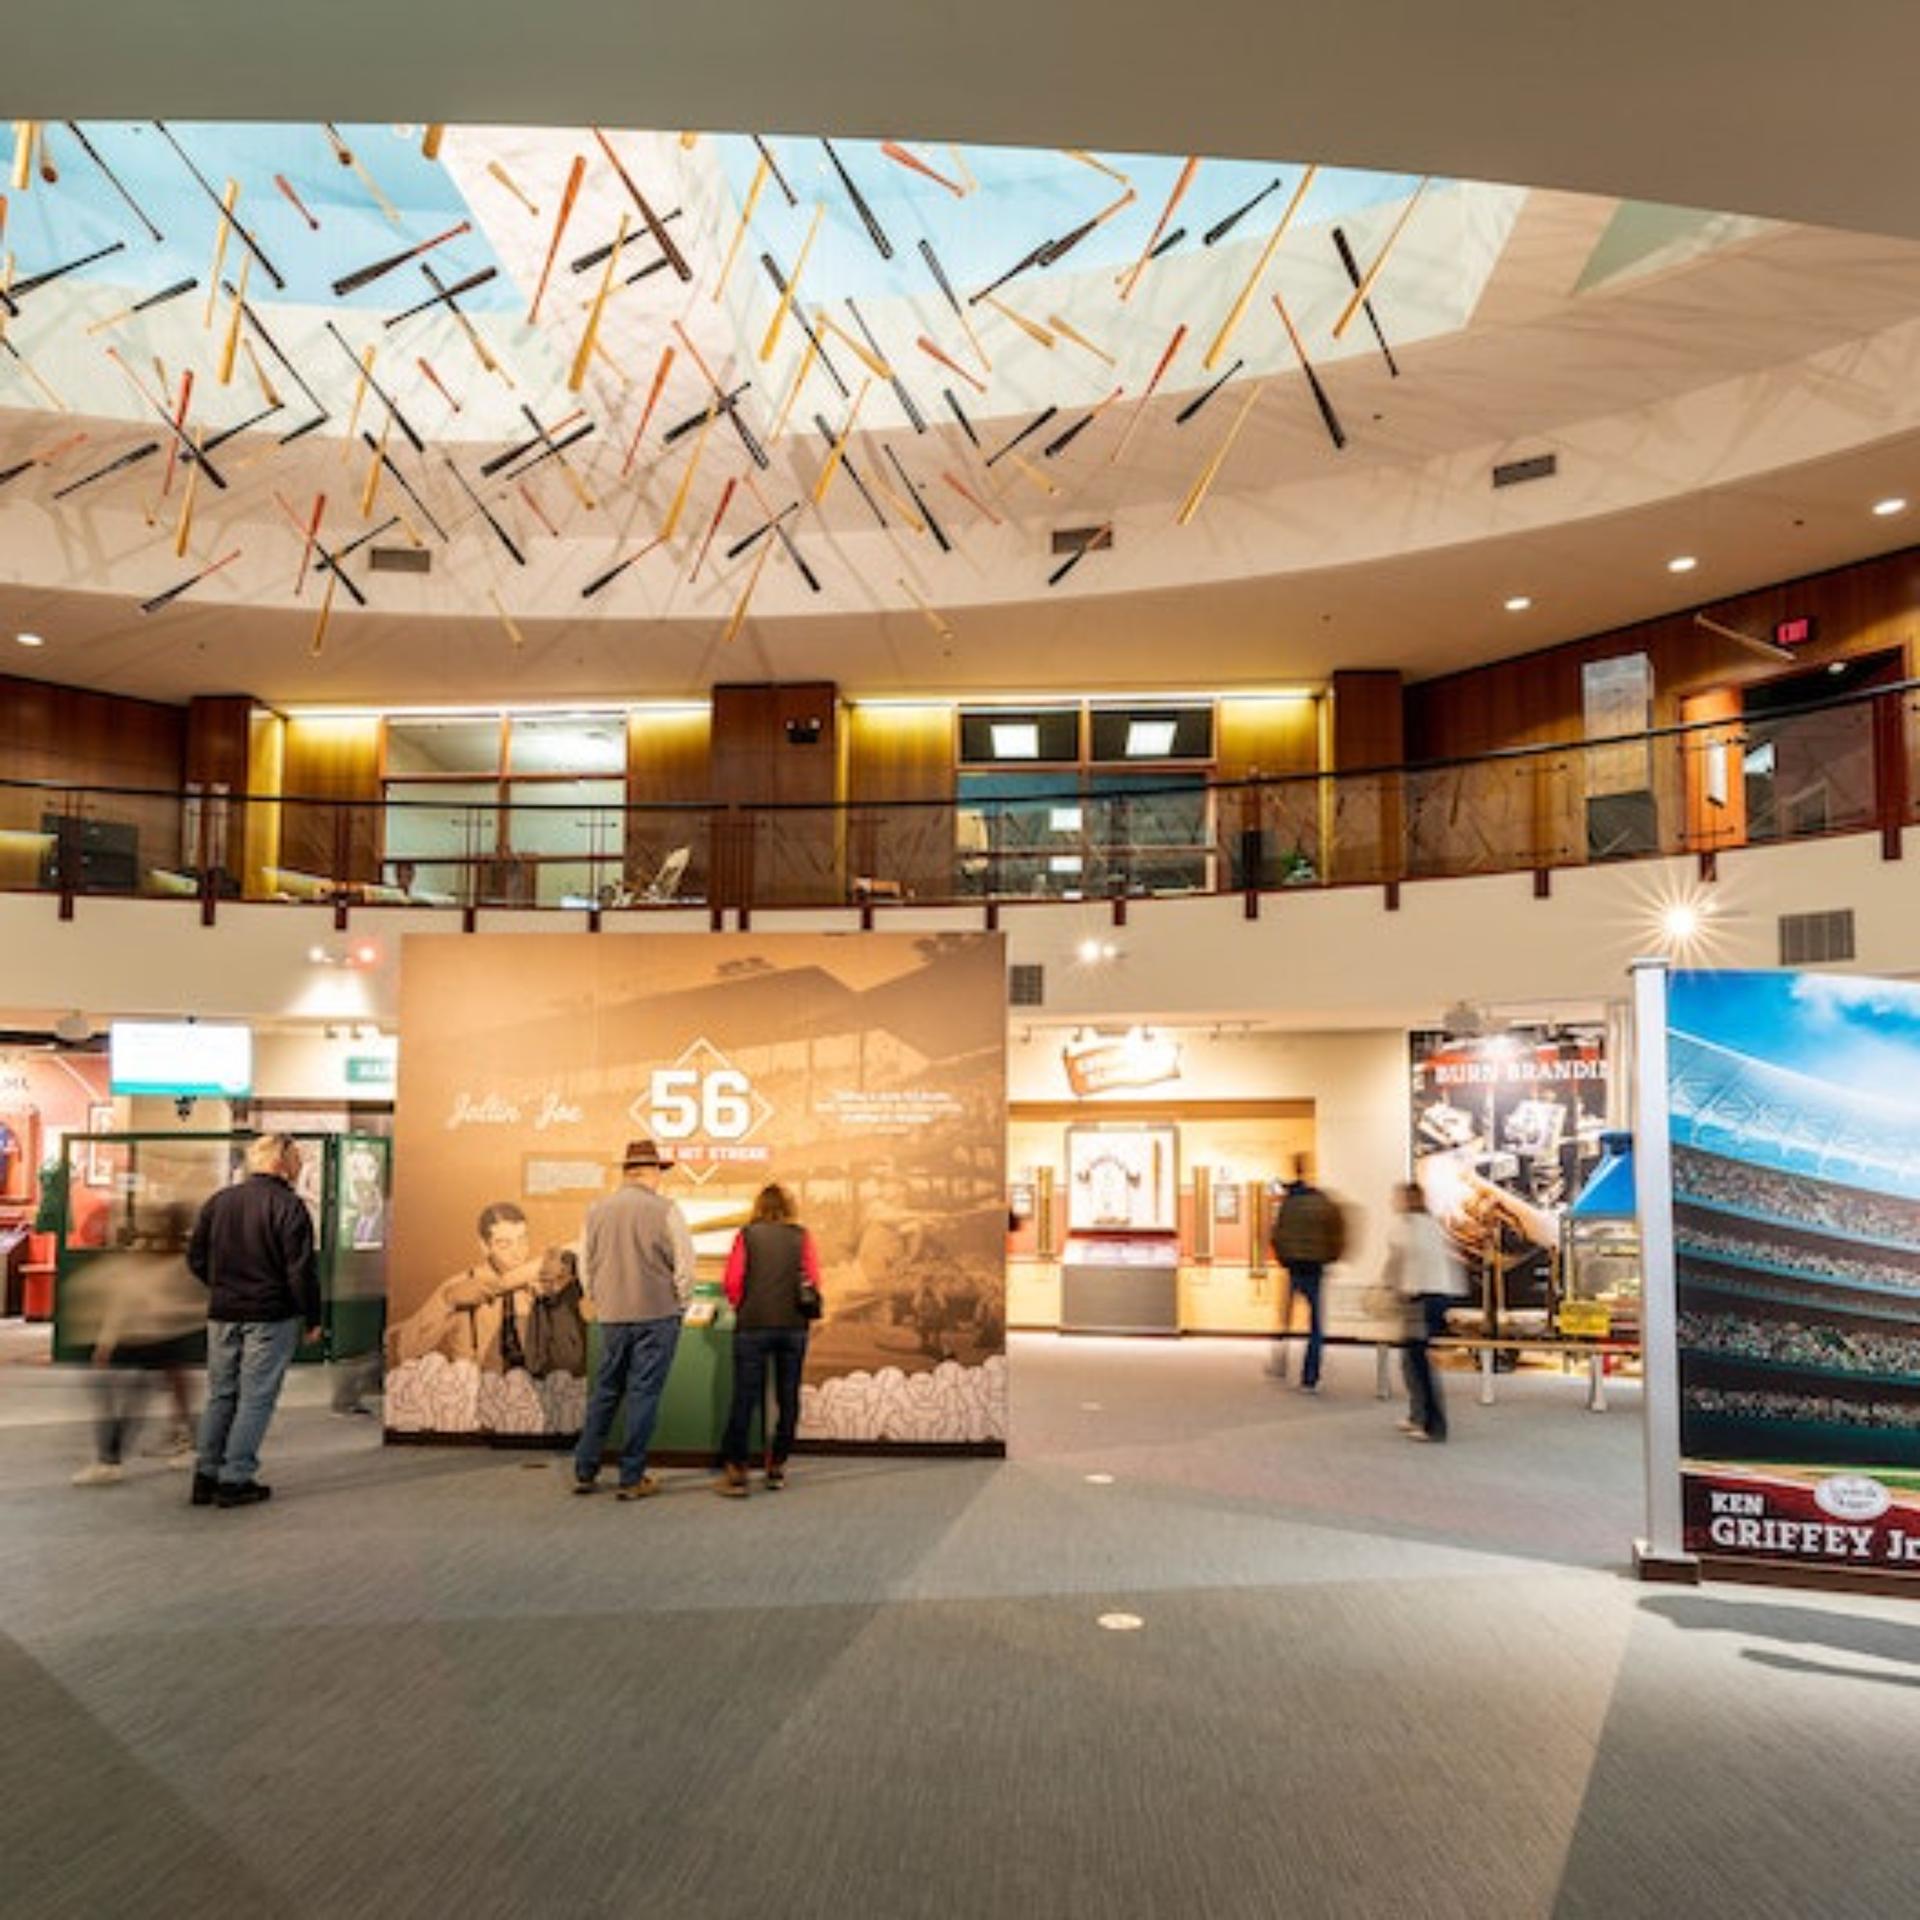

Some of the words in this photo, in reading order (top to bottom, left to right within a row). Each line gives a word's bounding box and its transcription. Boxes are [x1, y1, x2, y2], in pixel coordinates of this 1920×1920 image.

[650, 1068, 750, 1139] 56
[1710, 1492, 1764, 1515] KEN
[1711, 1516, 1874, 1557] GRIFFEY
